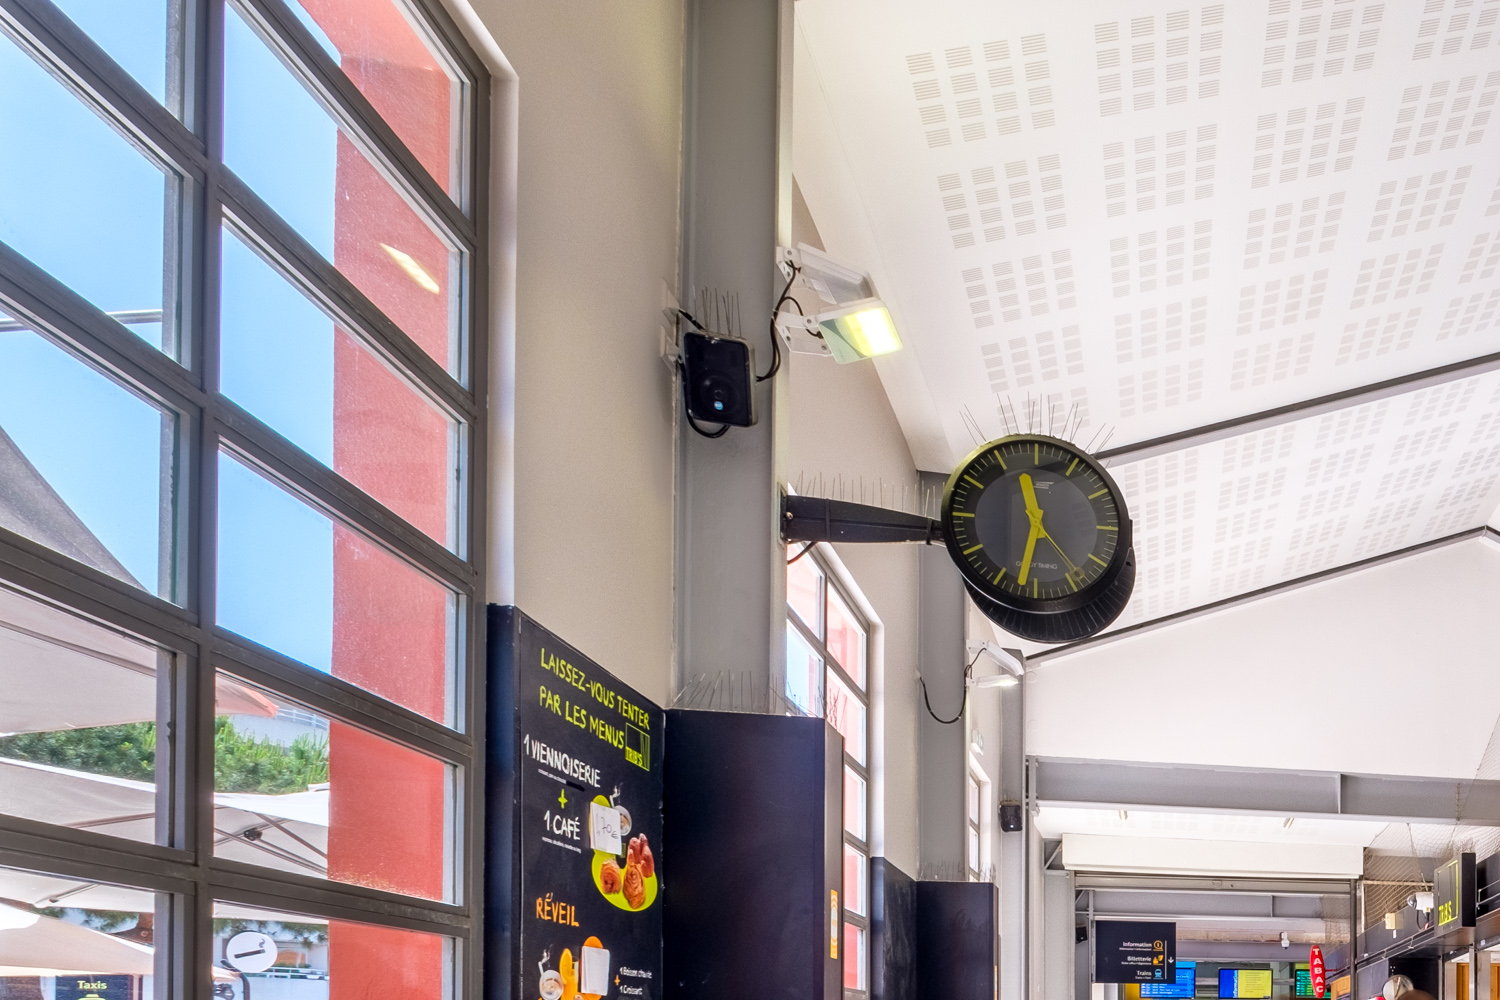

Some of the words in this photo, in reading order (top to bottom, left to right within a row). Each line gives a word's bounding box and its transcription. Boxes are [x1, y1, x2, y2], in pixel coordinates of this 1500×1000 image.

[540, 647, 616, 709] LAISSEZ-VOUS
[617, 695, 650, 731] TENTER
[539, 685, 562, 716] PAR
[565, 701, 587, 729] LES
[589, 715, 625, 750] MENUS
[523, 733, 530, 756] 1
[531, 739, 601, 788] VIENNOISERIE
[543, 809, 550, 832] 1
[552, 815, 581, 841] CAFÉ
[535, 892, 580, 928] RÉVEIL
[77, 980, 108, 990] Taxis
[1312, 948, 1324, 993] TABAC
